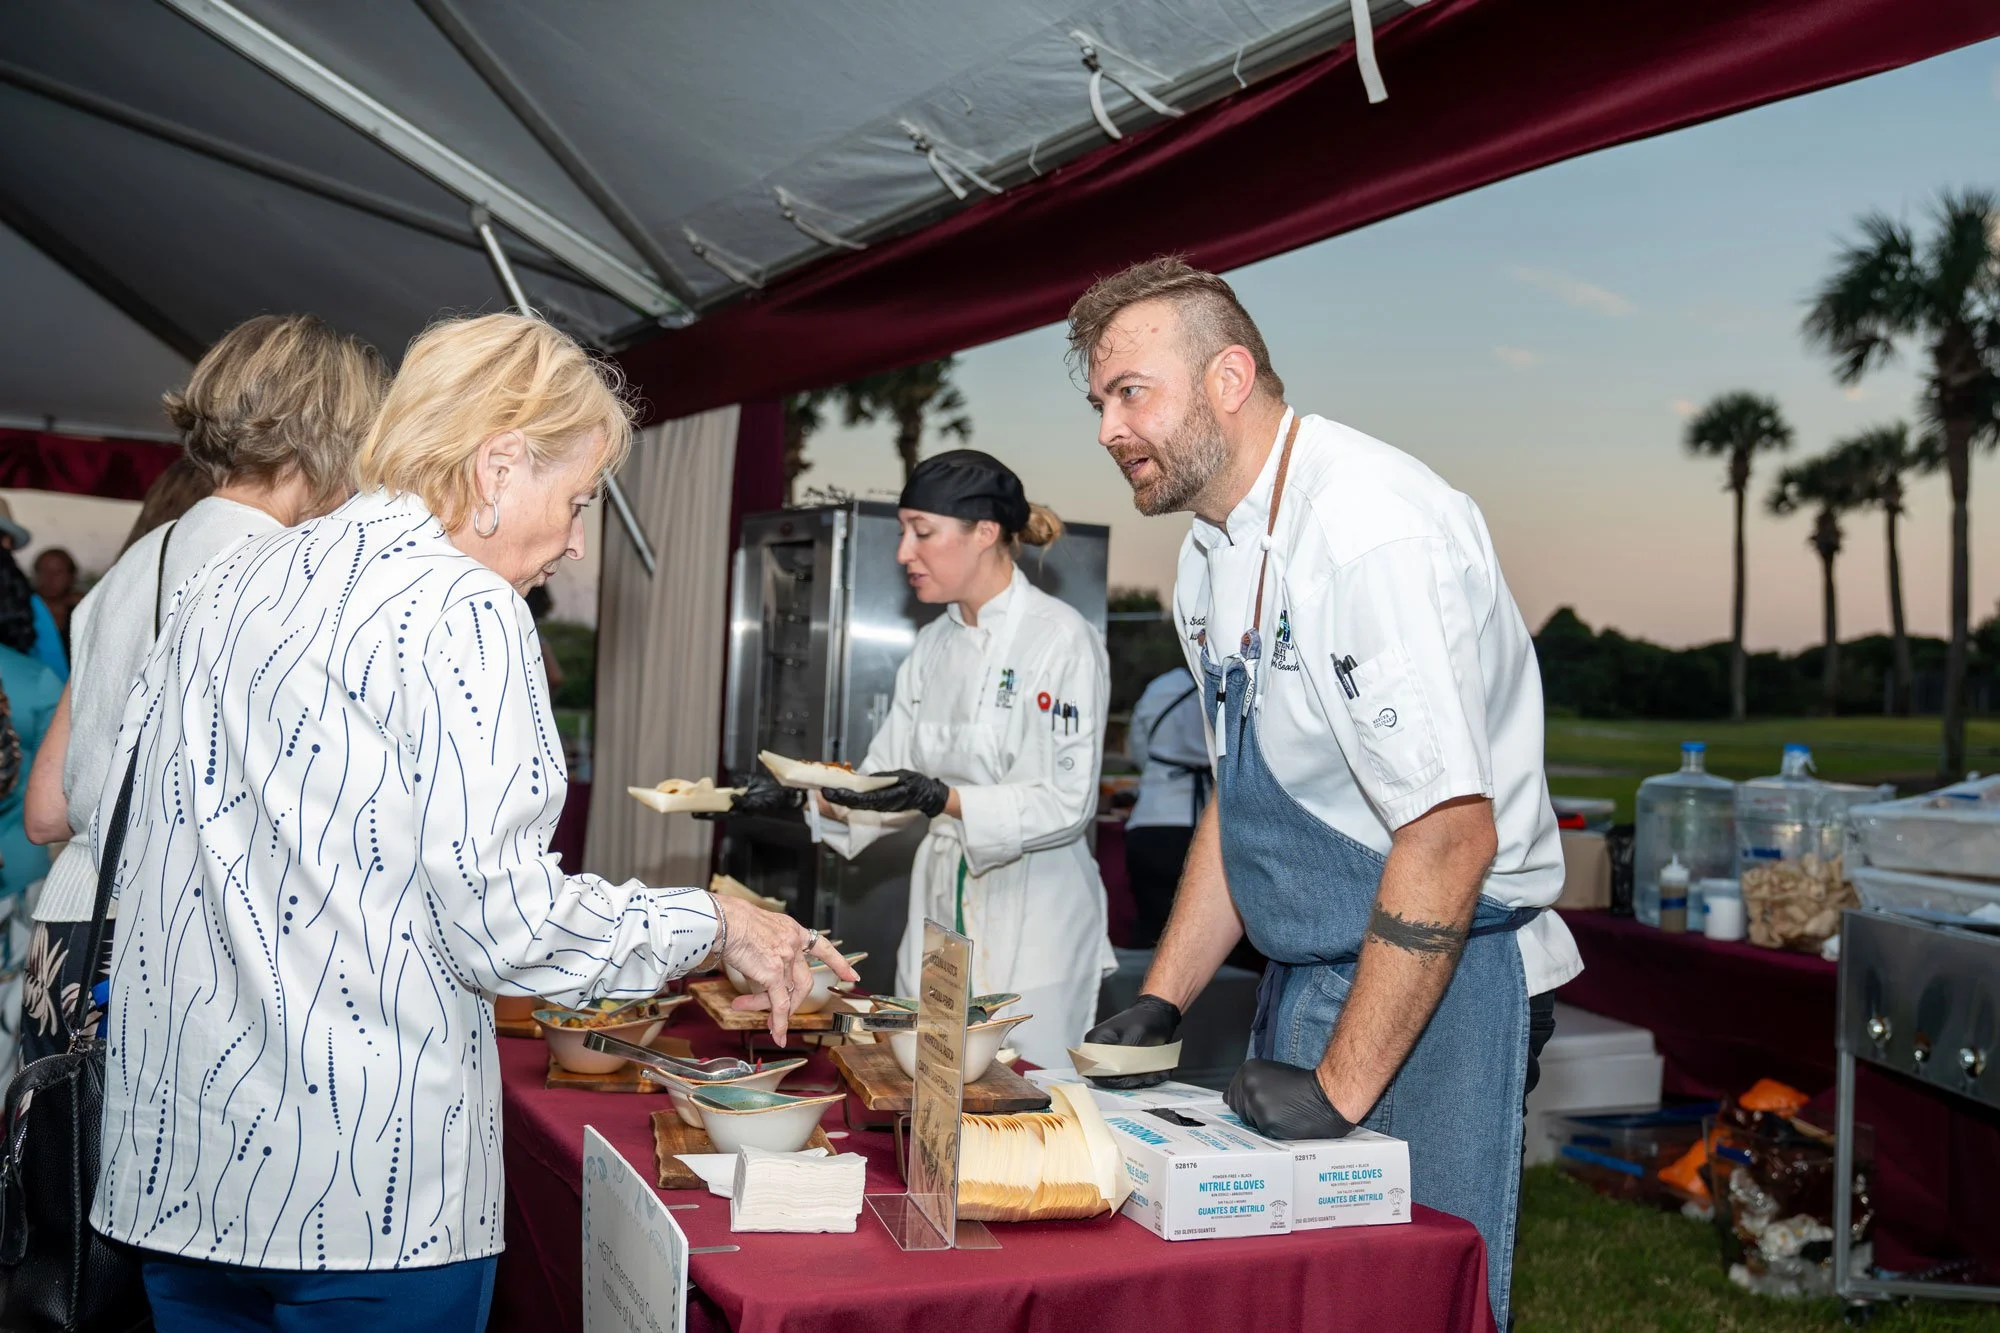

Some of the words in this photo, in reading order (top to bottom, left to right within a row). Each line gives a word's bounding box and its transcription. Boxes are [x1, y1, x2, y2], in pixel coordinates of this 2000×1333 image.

[1319, 1171, 1349, 1182] NITRILE
[1352, 1169, 1383, 1180] GLOVES
[1199, 1181, 1231, 1192] NITRILE
[1233, 1180, 1265, 1190] GLOVES
[1318, 1196, 1347, 1205] GUANTES
[1349, 1195, 1356, 1203] DE
[1358, 1193, 1383, 1202] NITRILO
[1198, 1206, 1228, 1216] GUANTES
[1230, 1205, 1238, 1213] DE
[1240, 1204, 1265, 1213] NITRILO
[598, 1236, 614, 1271] HGTC
[614, 1255, 645, 1318] International
[602, 1273, 621, 1316] Institute
